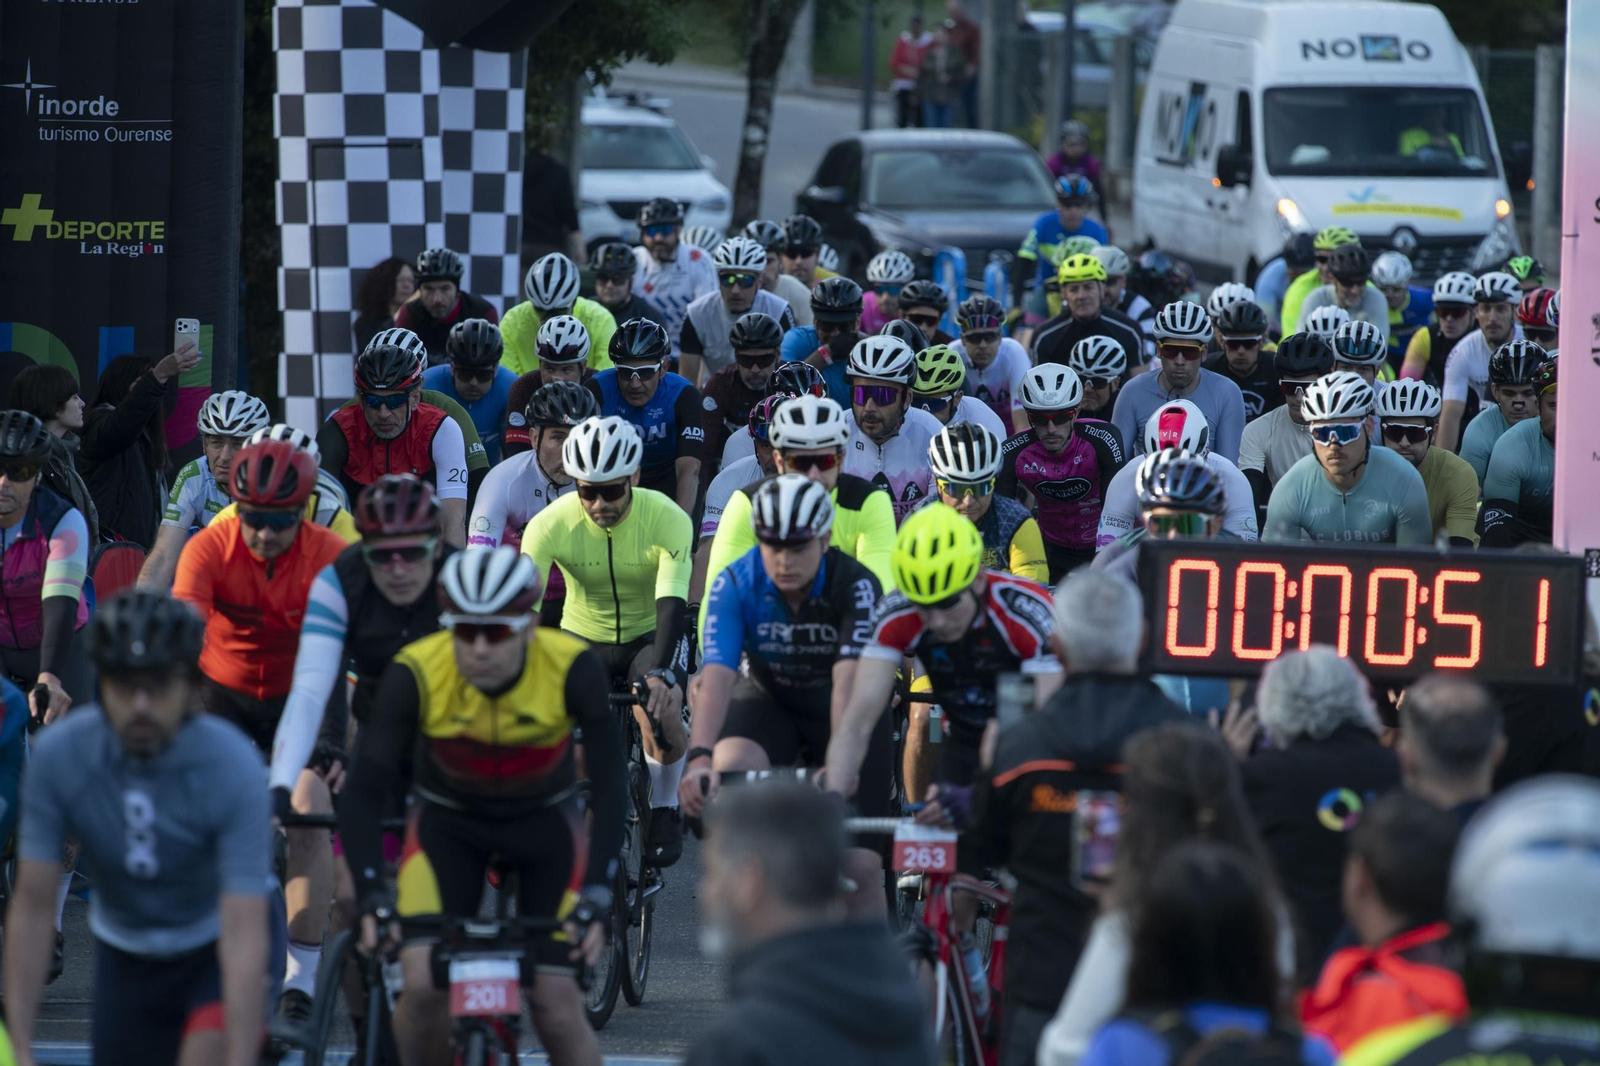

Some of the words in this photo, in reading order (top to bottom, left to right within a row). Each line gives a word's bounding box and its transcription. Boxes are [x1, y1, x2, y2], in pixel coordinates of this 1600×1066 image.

[38, 94, 119, 116] inorde
[38, 126, 99, 141] turismo
[104, 126, 173, 142] Ourense
[46, 221, 165, 240] DEPORTE
[80, 242, 103, 254] La
[903, 846, 946, 867] 263
[463, 986, 506, 1010] 201
